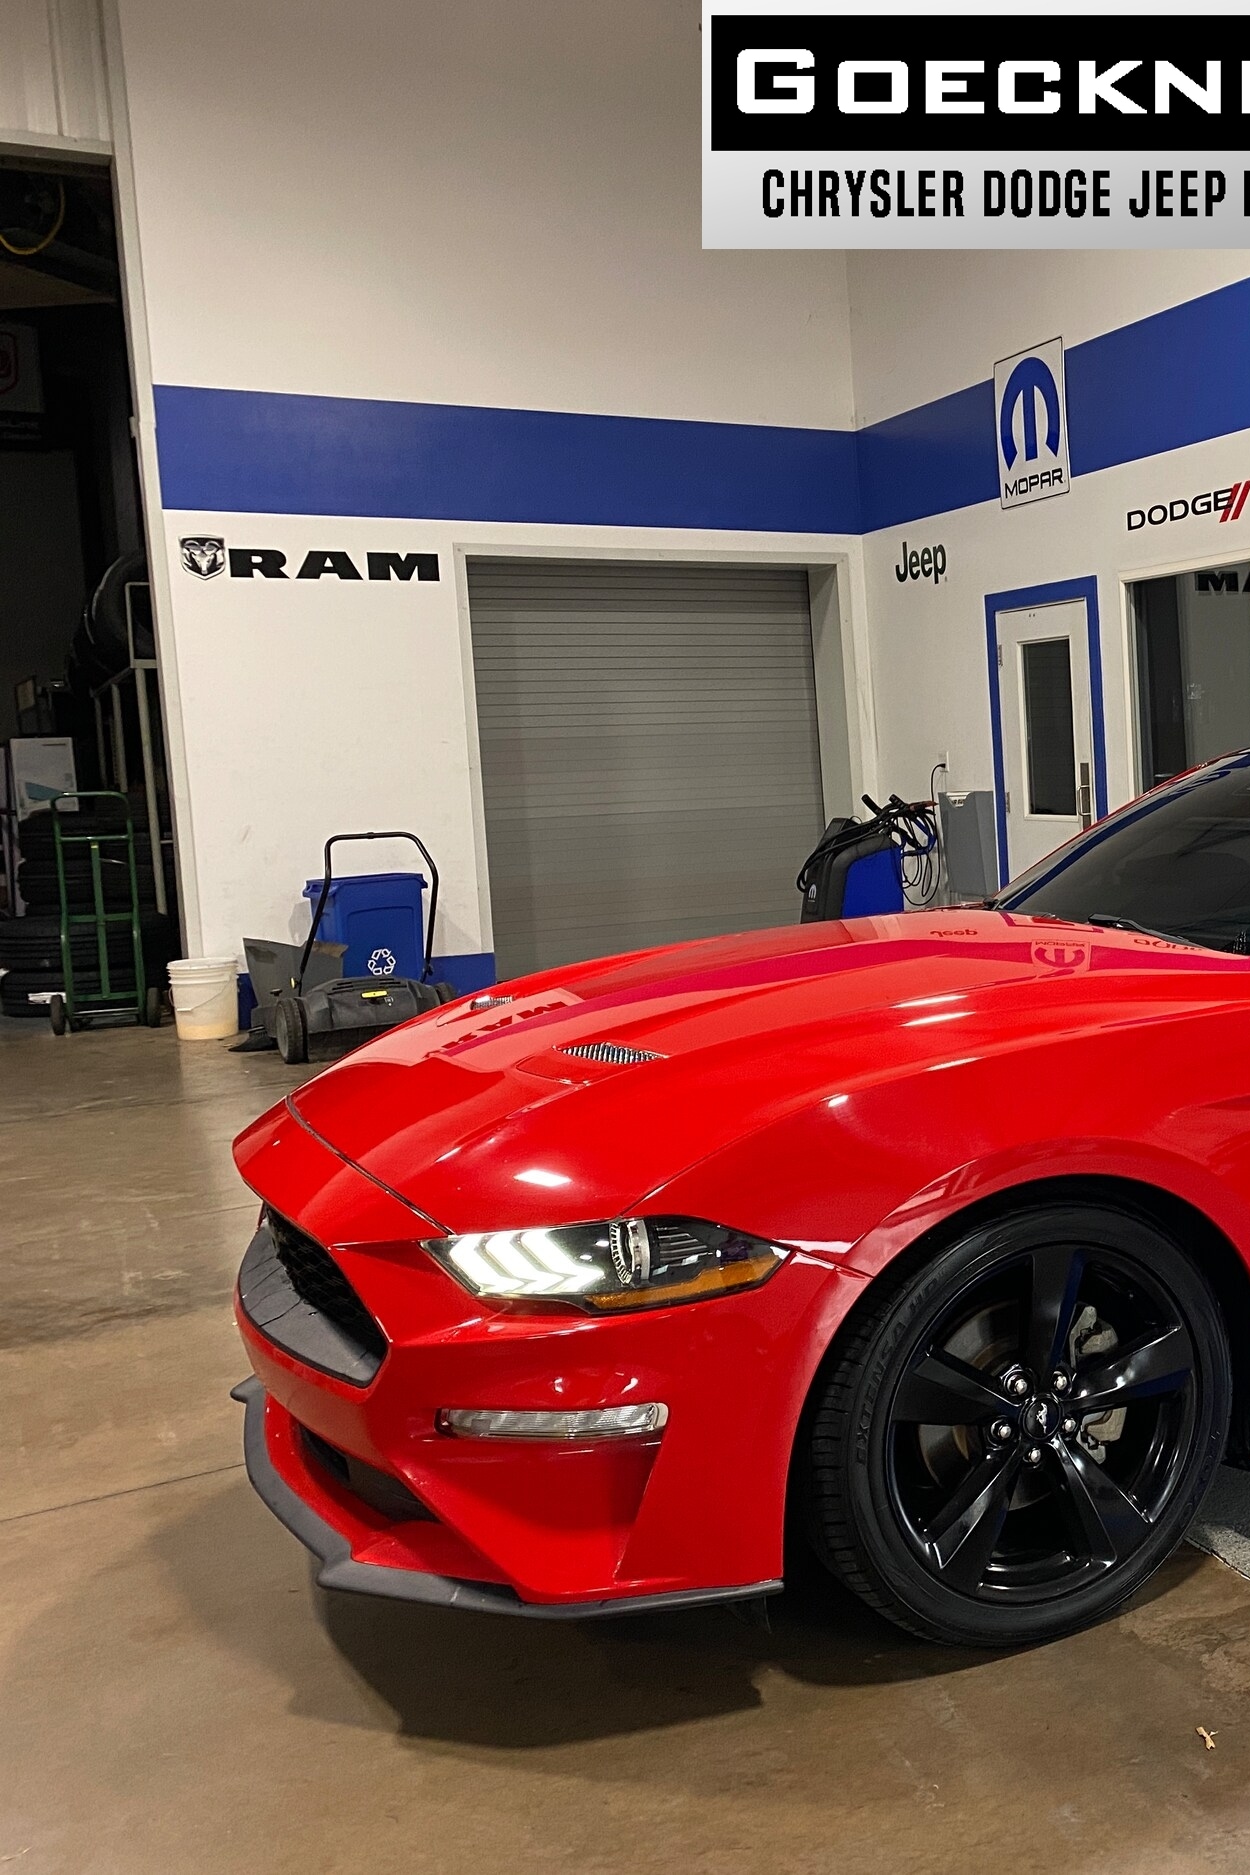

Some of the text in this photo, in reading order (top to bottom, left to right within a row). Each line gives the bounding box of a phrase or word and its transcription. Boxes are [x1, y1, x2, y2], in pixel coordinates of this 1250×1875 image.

[1004, 467, 1064, 499] MOPAR
[1126, 487, 1234, 531] DODGE
[228, 548, 440, 582] RAM
[895, 541, 947, 584] Jeep
